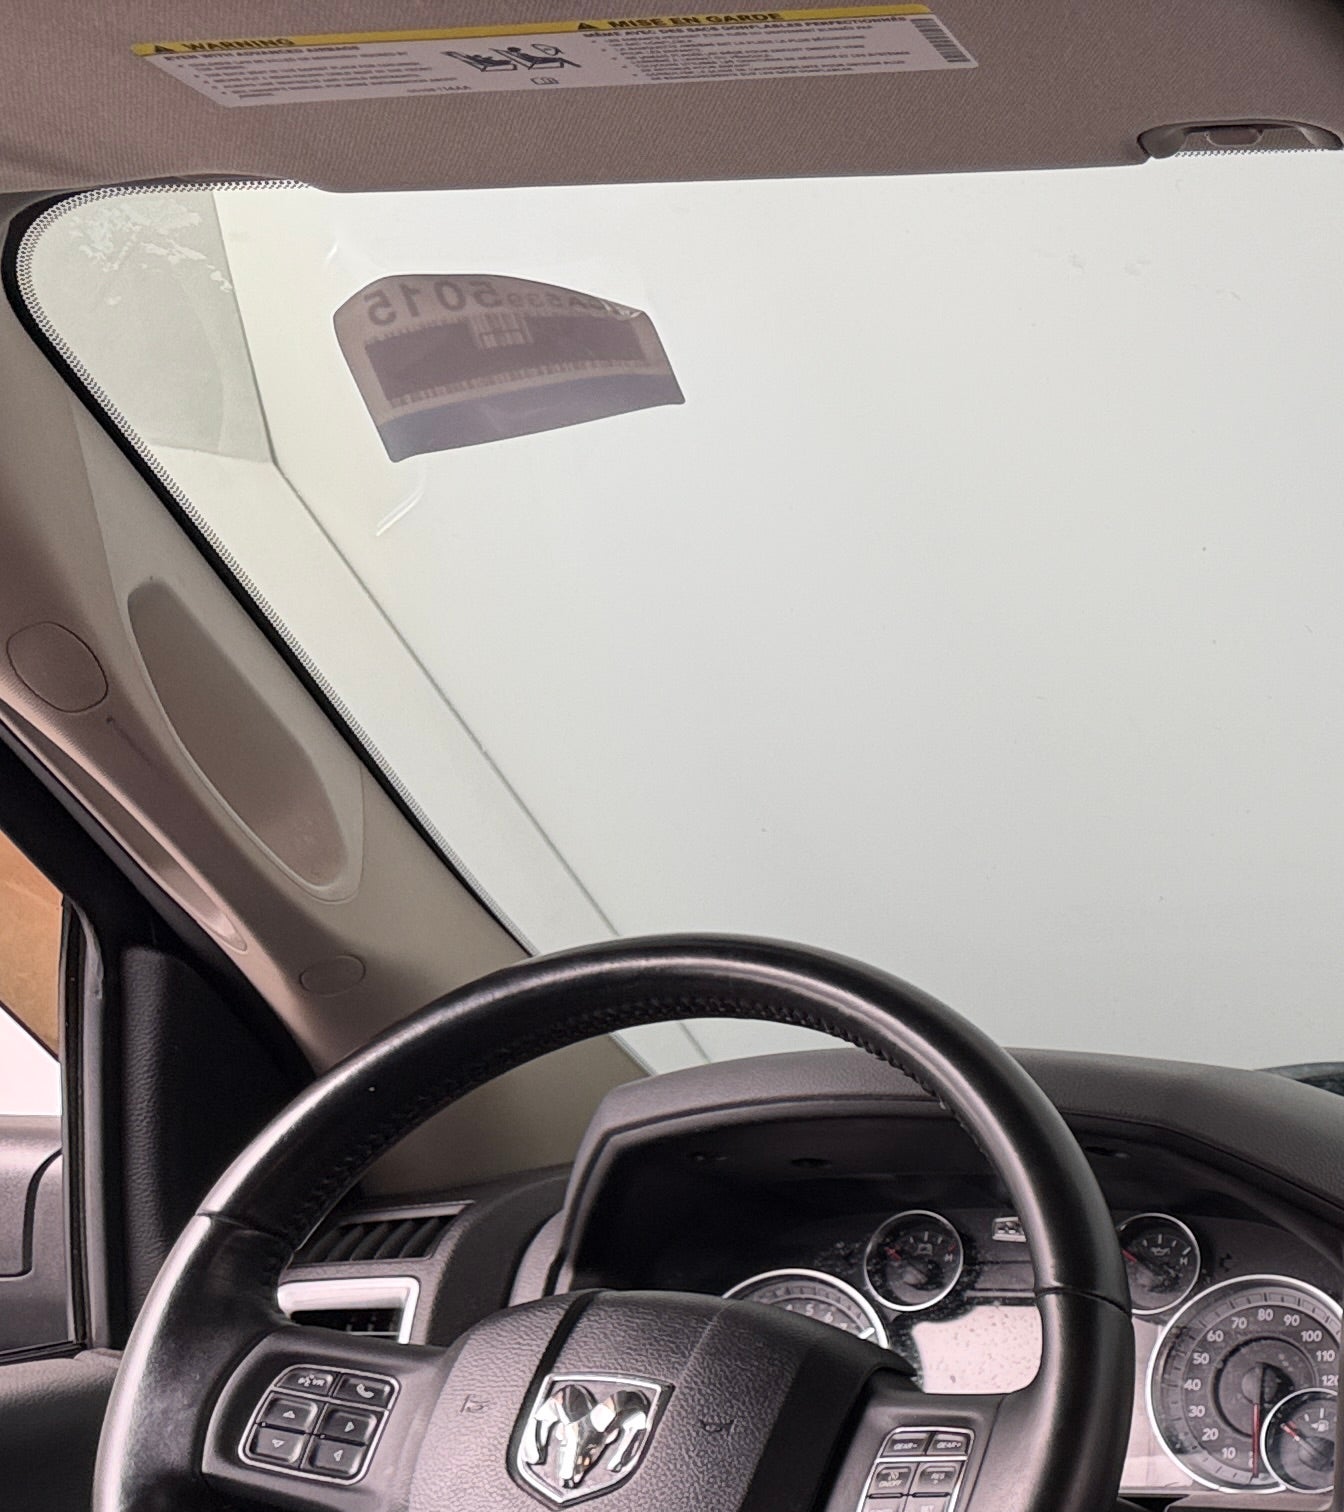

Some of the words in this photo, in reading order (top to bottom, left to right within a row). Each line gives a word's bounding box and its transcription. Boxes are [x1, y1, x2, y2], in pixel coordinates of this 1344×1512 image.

[608, 17, 668, 28] MISE
[669, 16, 699, 25] EN
[706, 13, 784, 23] GARDE
[182, 38, 295, 51] WARNING
[236, 49, 304, 57] ADVANCED
[805, 1303, 815, 1317] 5
[1257, 1308, 1274, 1322] 80
[824, 1311, 834, 1323] 6
[1231, 1316, 1248, 1329] 70
[1283, 1314, 1300, 1327] 90
[1206, 1330, 1224, 1343] 60
[1301, 1330, 1322, 1342] 100
[1193, 1352, 1210, 1365] 50
[1316, 1350, 1336, 1362] 110
[1184, 1378, 1201, 1391] 40
[1188, 1405, 1205, 1418] 30
[1202, 1428, 1218, 1441] 20
[1221, 1447, 1237, 1460] 10
[921, 1504, 935, 1512] SET
